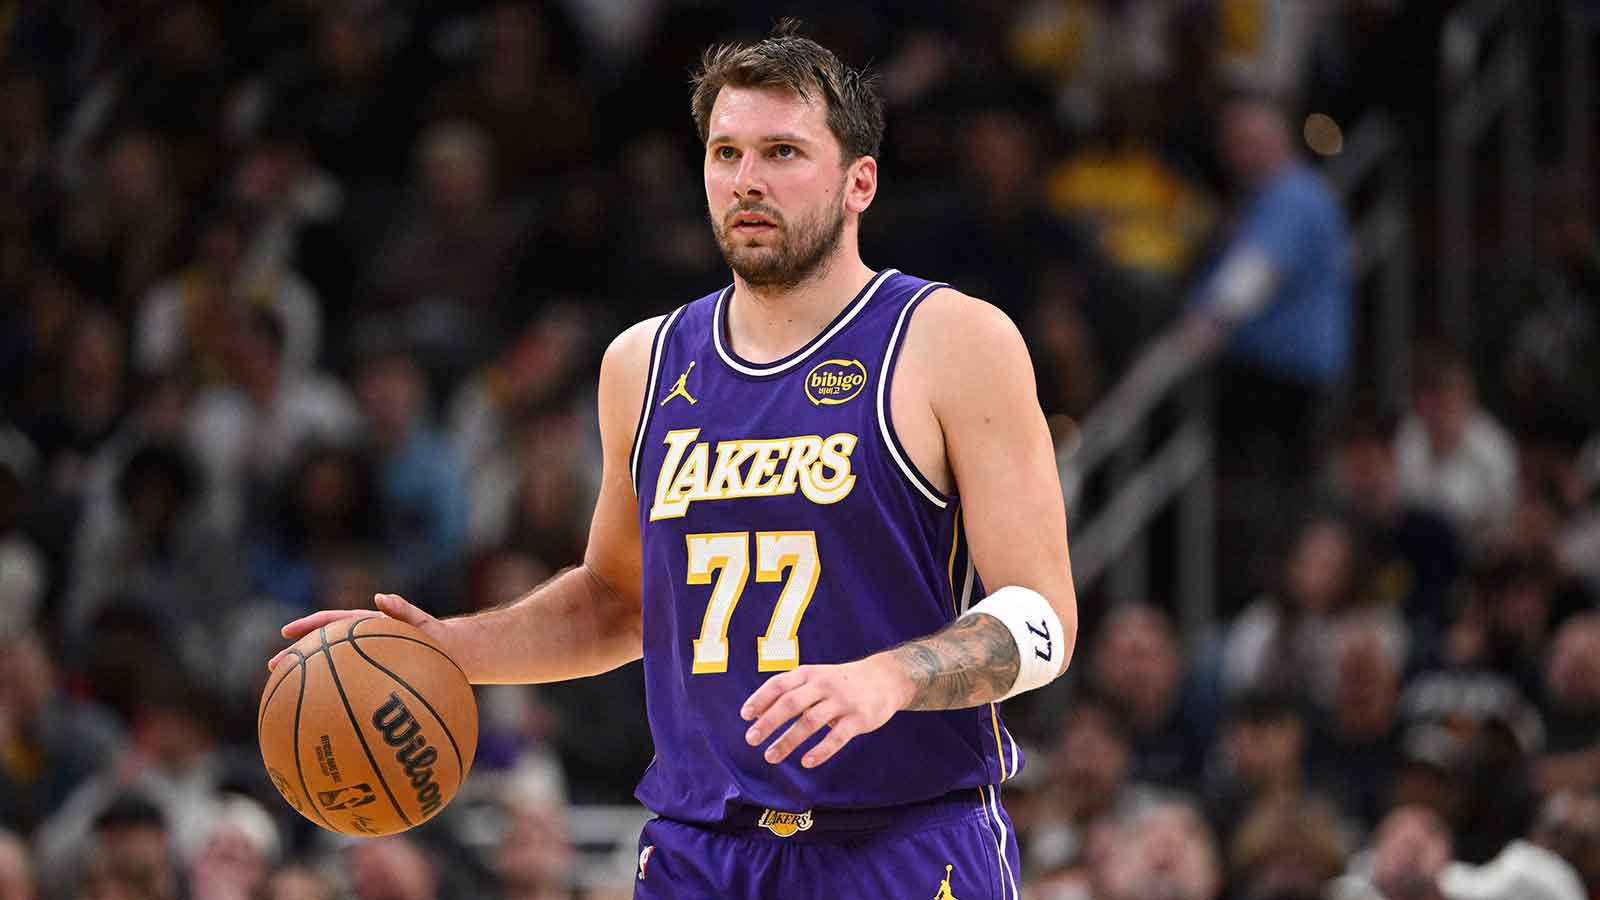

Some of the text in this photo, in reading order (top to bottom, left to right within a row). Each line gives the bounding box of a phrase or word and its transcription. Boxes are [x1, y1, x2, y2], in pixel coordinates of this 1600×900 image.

[811, 371, 863, 391] bibigo
[649, 428, 859, 522] LAKERS
[686, 531, 821, 674] 77
[372, 691, 442, 817] Wilson
[758, 808, 814, 831] LAKERS
